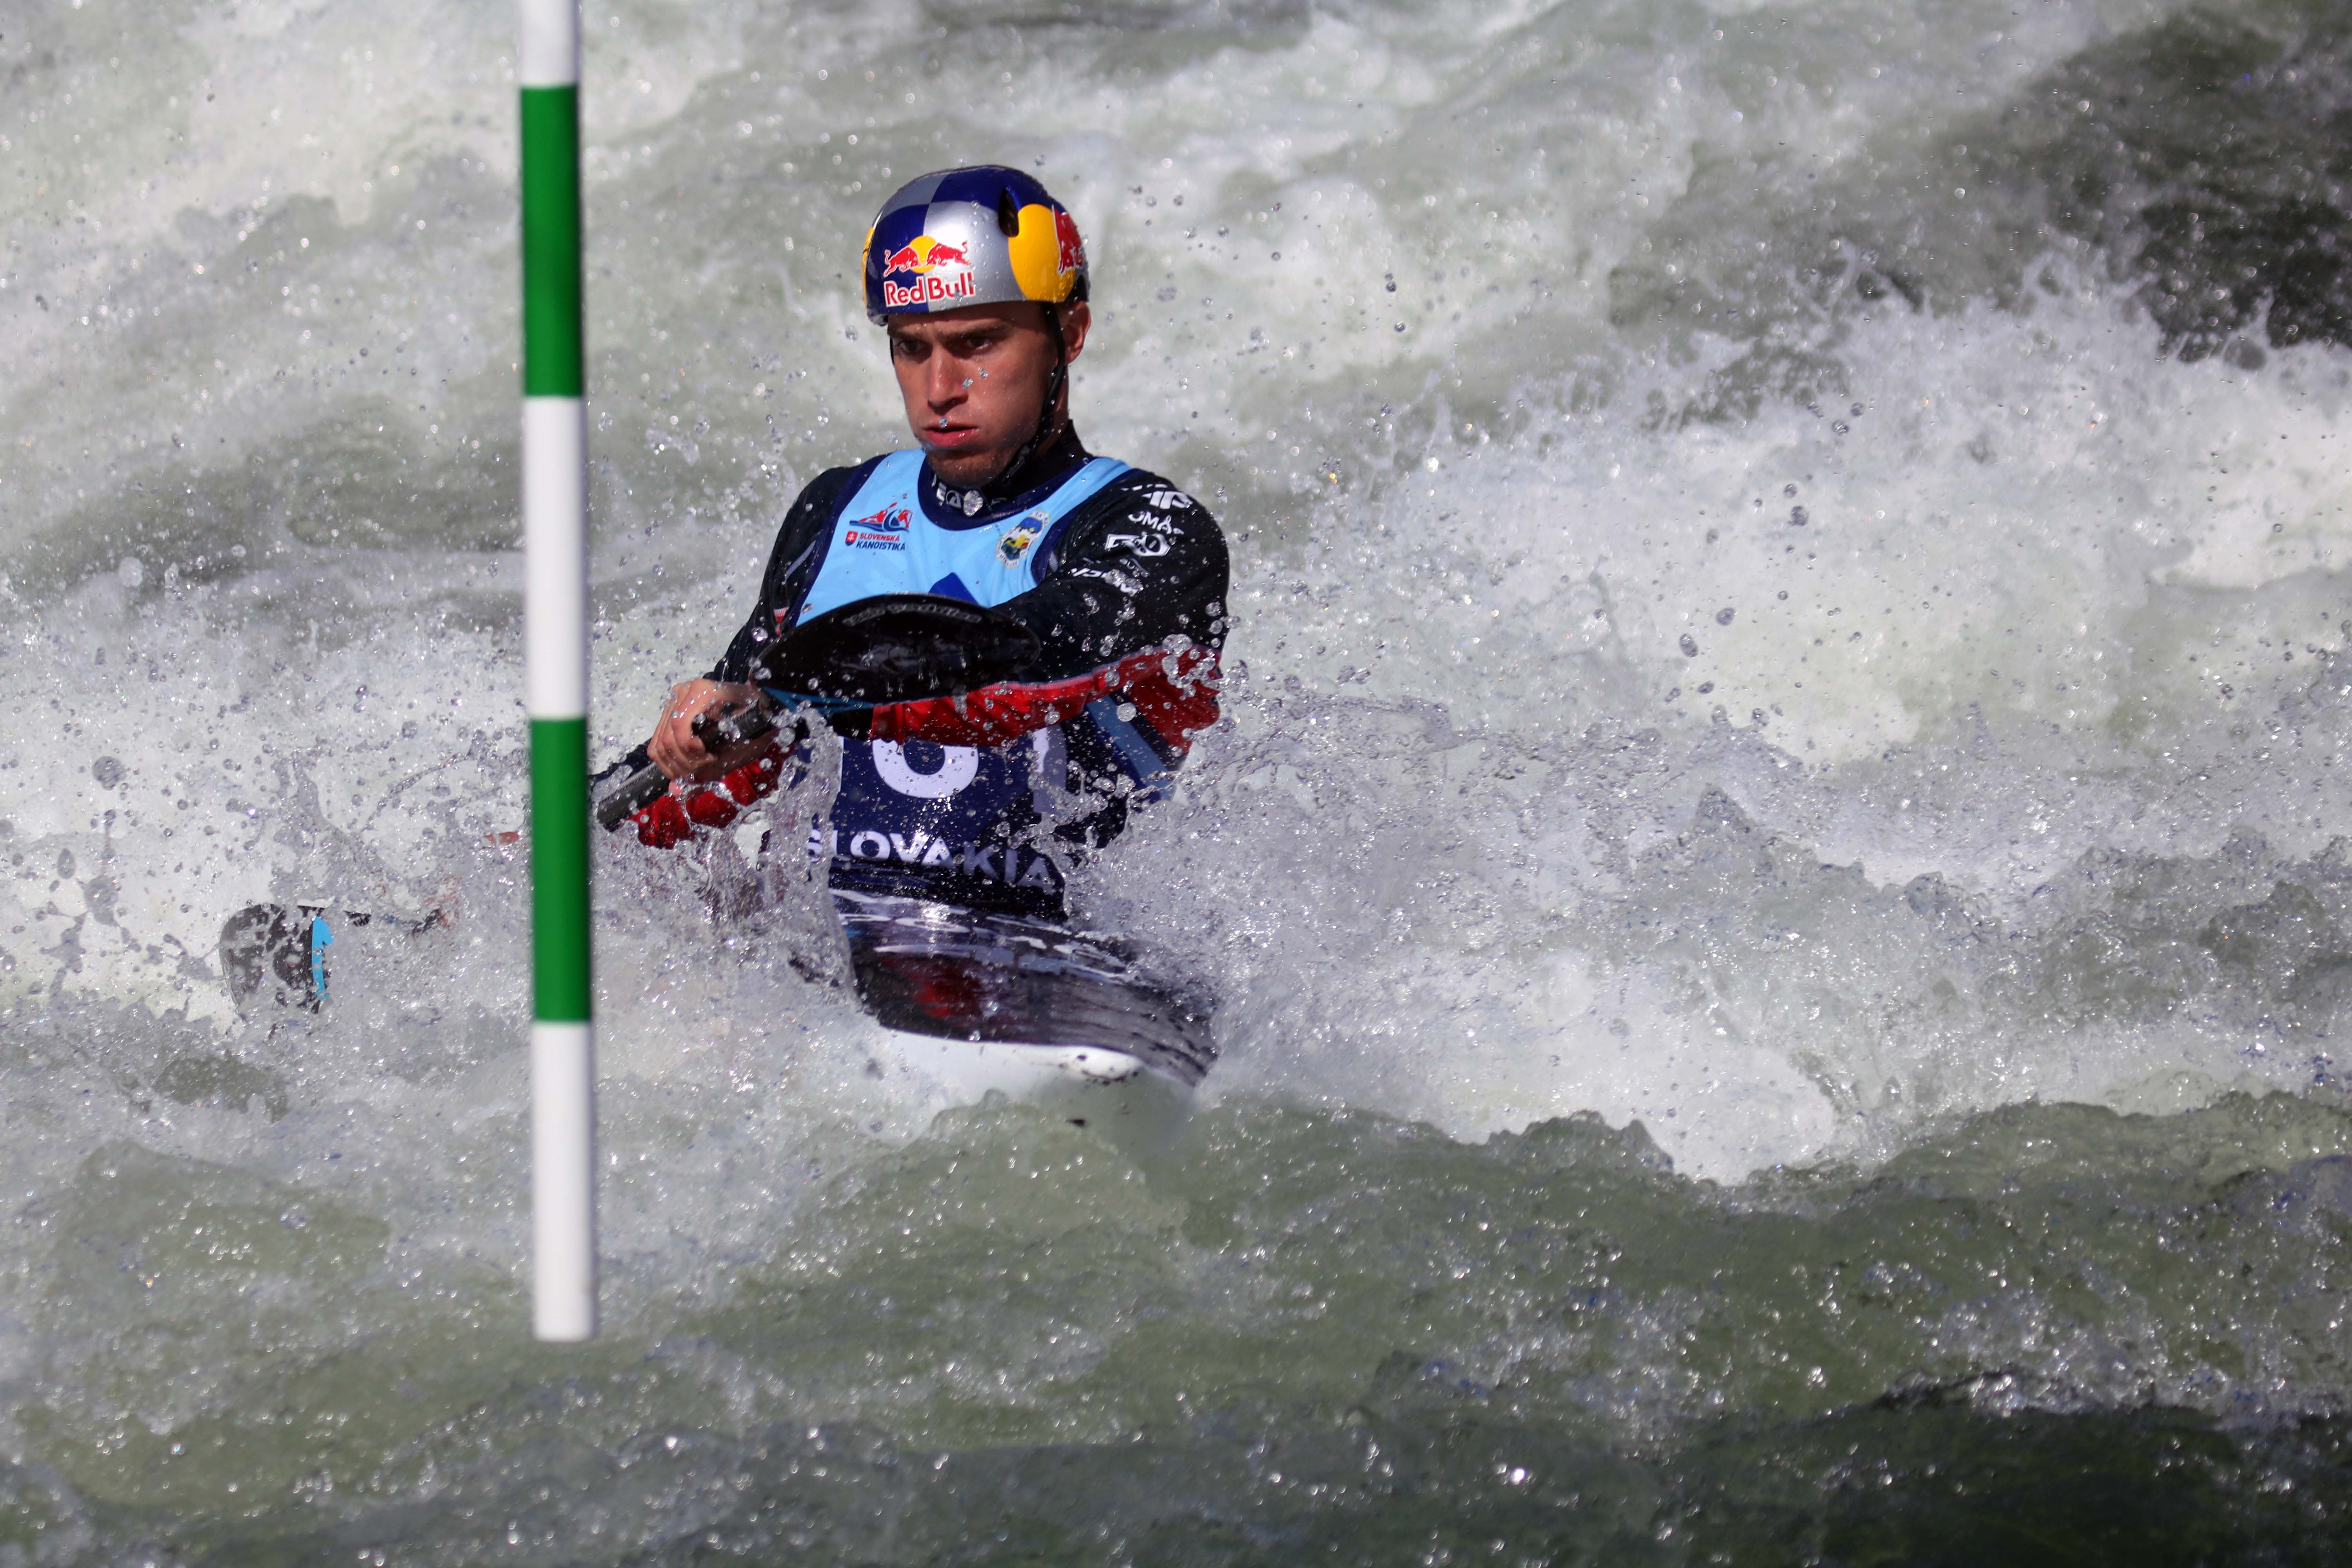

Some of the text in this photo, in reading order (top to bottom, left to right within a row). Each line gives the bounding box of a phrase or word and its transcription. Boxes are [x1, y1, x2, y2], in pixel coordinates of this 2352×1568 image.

[885, 271, 975, 306] Red Bull
[860, 532, 900, 542] SLOVENSKÁ
[856, 541, 906, 551] KANOISTIKA
